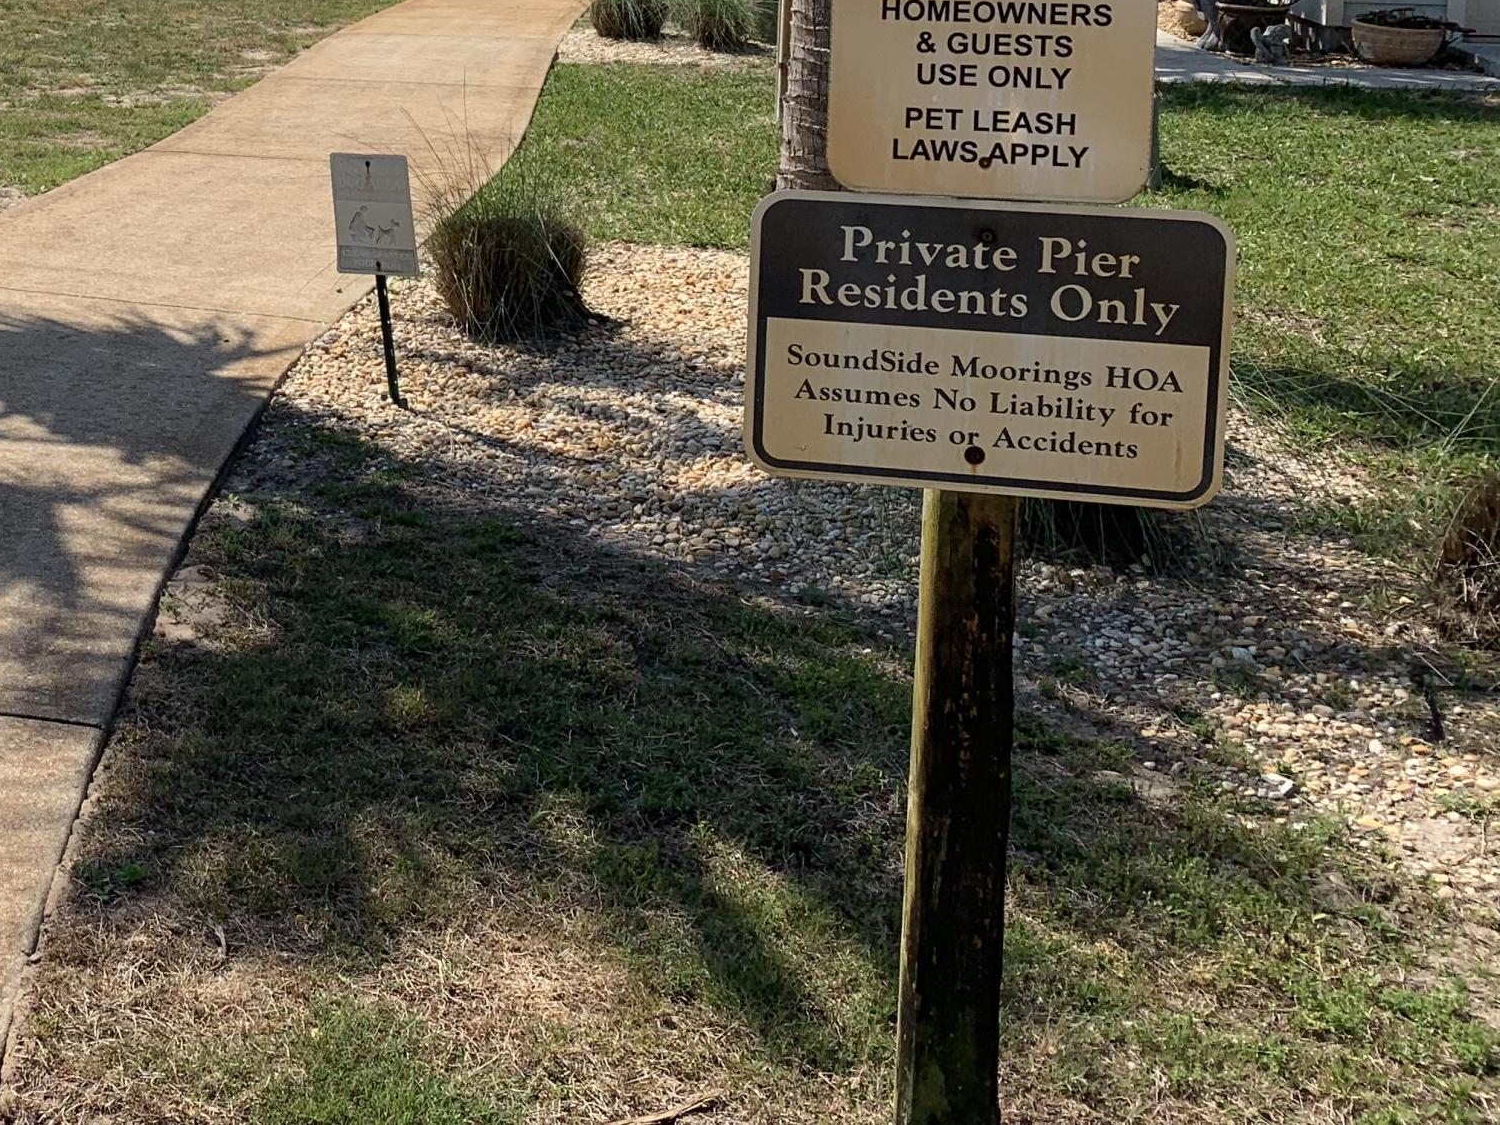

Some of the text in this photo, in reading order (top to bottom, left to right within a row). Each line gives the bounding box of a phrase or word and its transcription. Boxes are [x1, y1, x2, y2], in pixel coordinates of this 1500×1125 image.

[881, 0, 1112, 26] HOMEOWNERS
[916, 32, 1072, 57] & GUESTS
[917, 63, 1071, 89] USE ONLY
[905, 108, 1076, 135] PET LEASH
[892, 139, 1089, 168] LAWS APPLY
[841, 226, 1140, 278] Private Pier
[799, 268, 1180, 335] Residents Only
[787, 344, 1183, 393] SoundSide Moorings HOA
[795, 380, 1173, 428] Assumes No Liability for
[824, 414, 1138, 459] Injuries or Accidents
